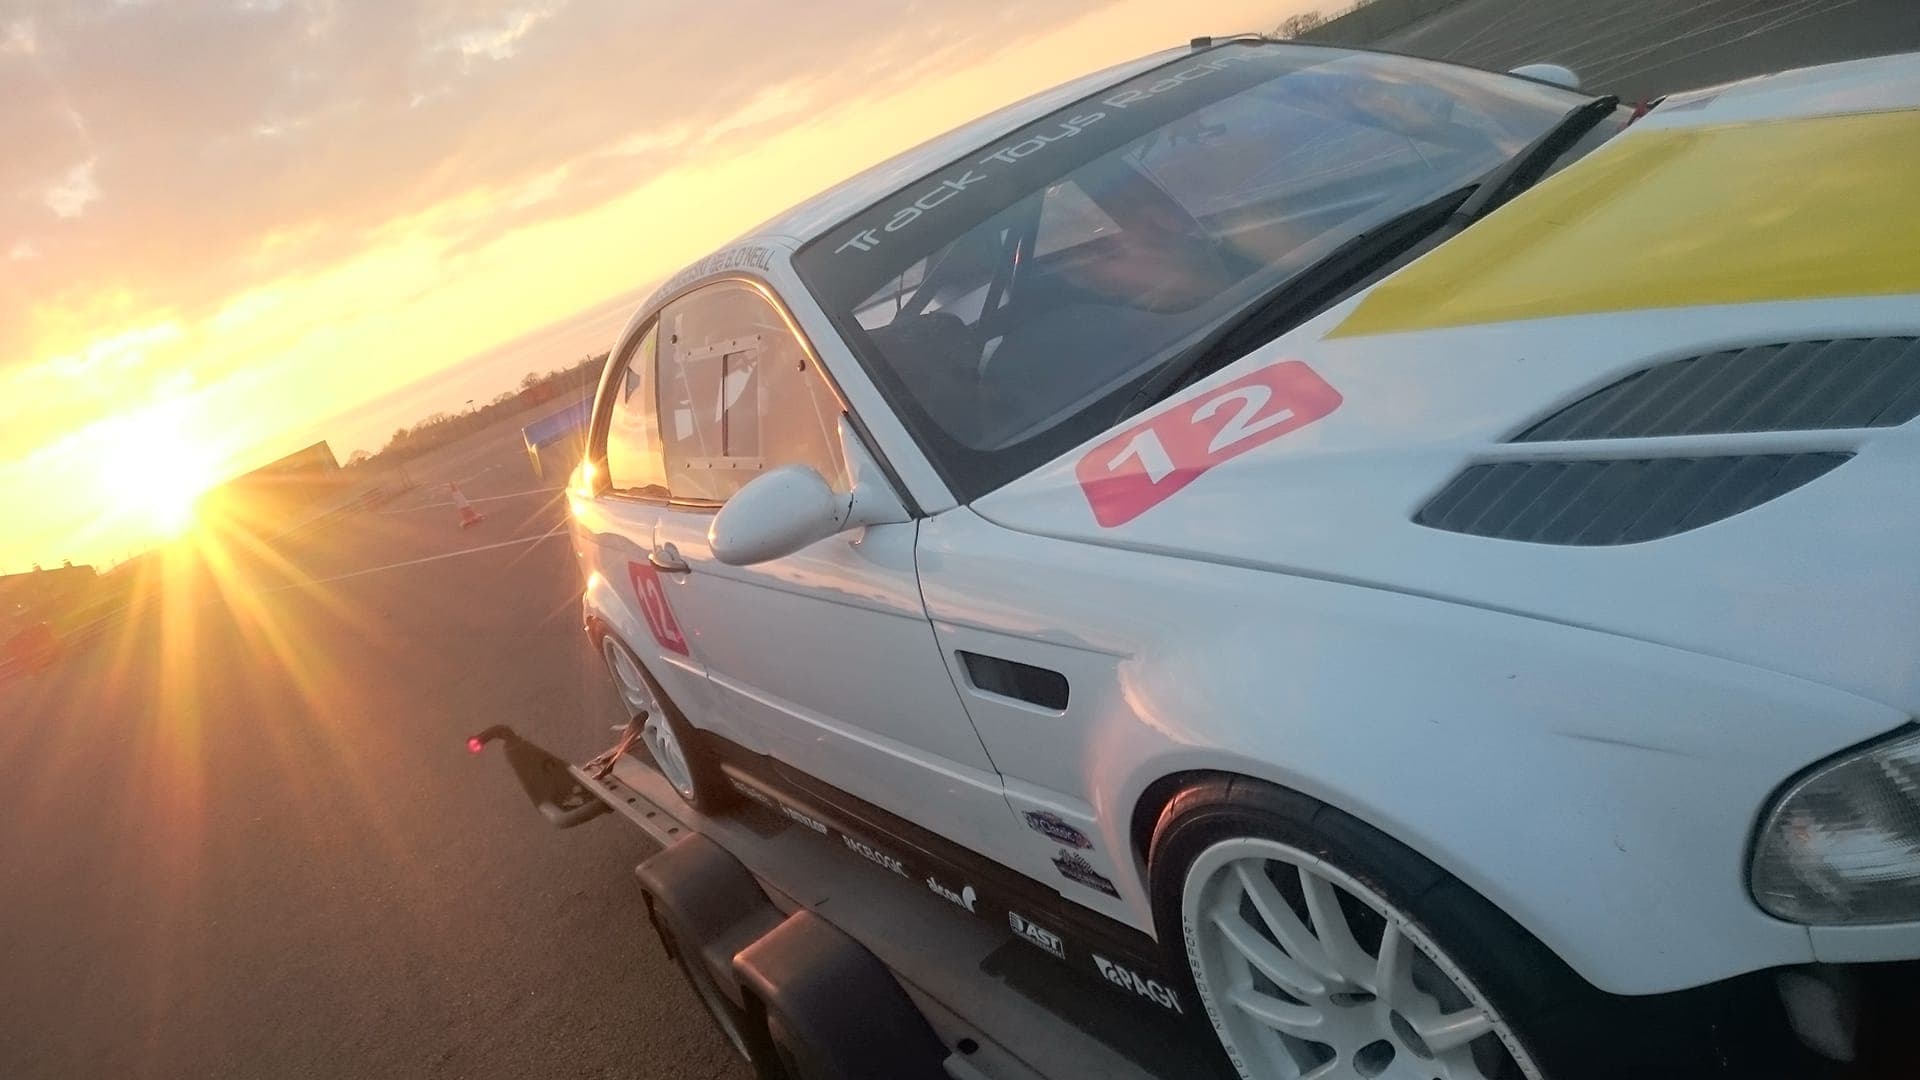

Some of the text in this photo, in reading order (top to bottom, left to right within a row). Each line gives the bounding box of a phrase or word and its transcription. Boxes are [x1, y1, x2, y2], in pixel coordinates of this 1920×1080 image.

[834, 170, 987, 254] Track
[979, 112, 1106, 164] Toys
[1107, 384, 1295, 485] 12
[637, 575, 680, 643] 12
[1113, 964, 1184, 1015] PAGI
